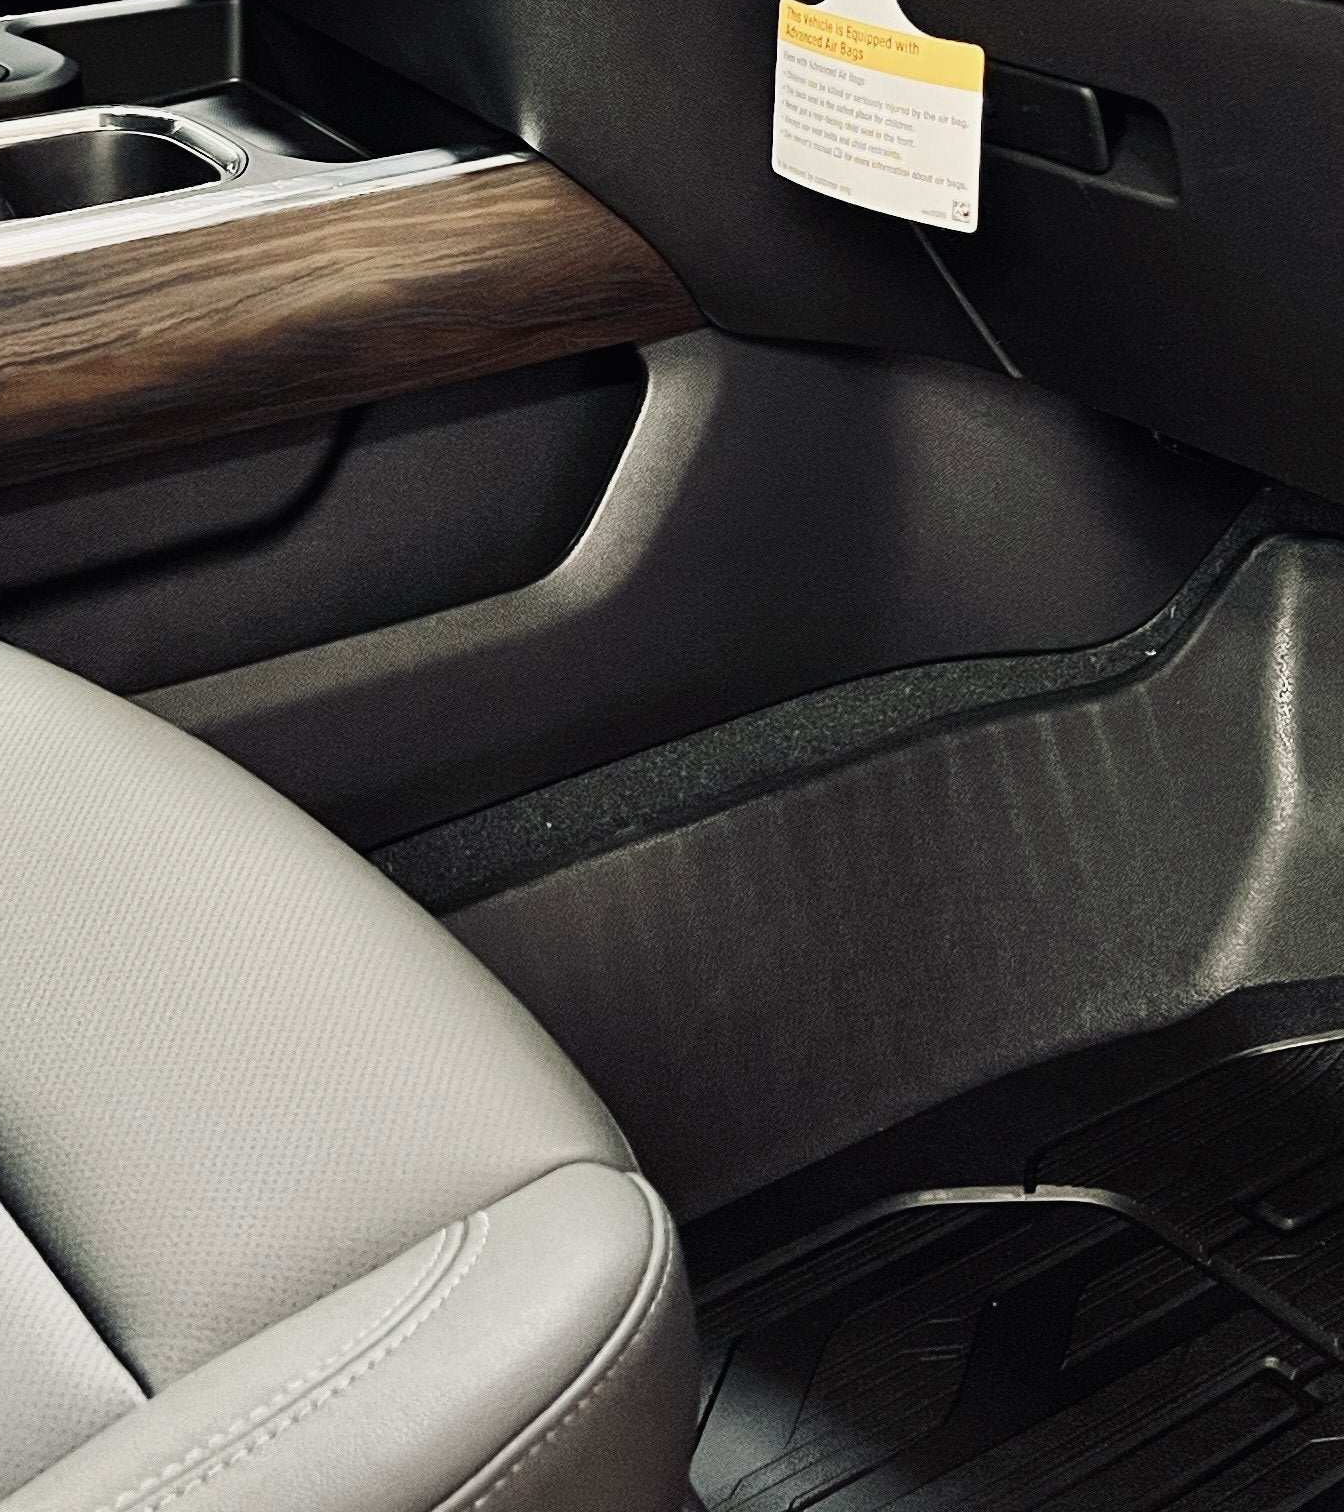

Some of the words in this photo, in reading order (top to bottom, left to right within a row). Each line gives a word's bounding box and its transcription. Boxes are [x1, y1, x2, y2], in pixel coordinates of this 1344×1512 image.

[785, 23, 823, 48] Advanced
[825, 37, 838, 53] Air
[840, 42, 864, 61] Bags
[787, 6, 801, 23] This
[804, 12, 833, 34] Vehicle
[835, 23, 843, 37] is
[846, 26, 892, 49] Equipped
[896, 39, 920, 56] with
